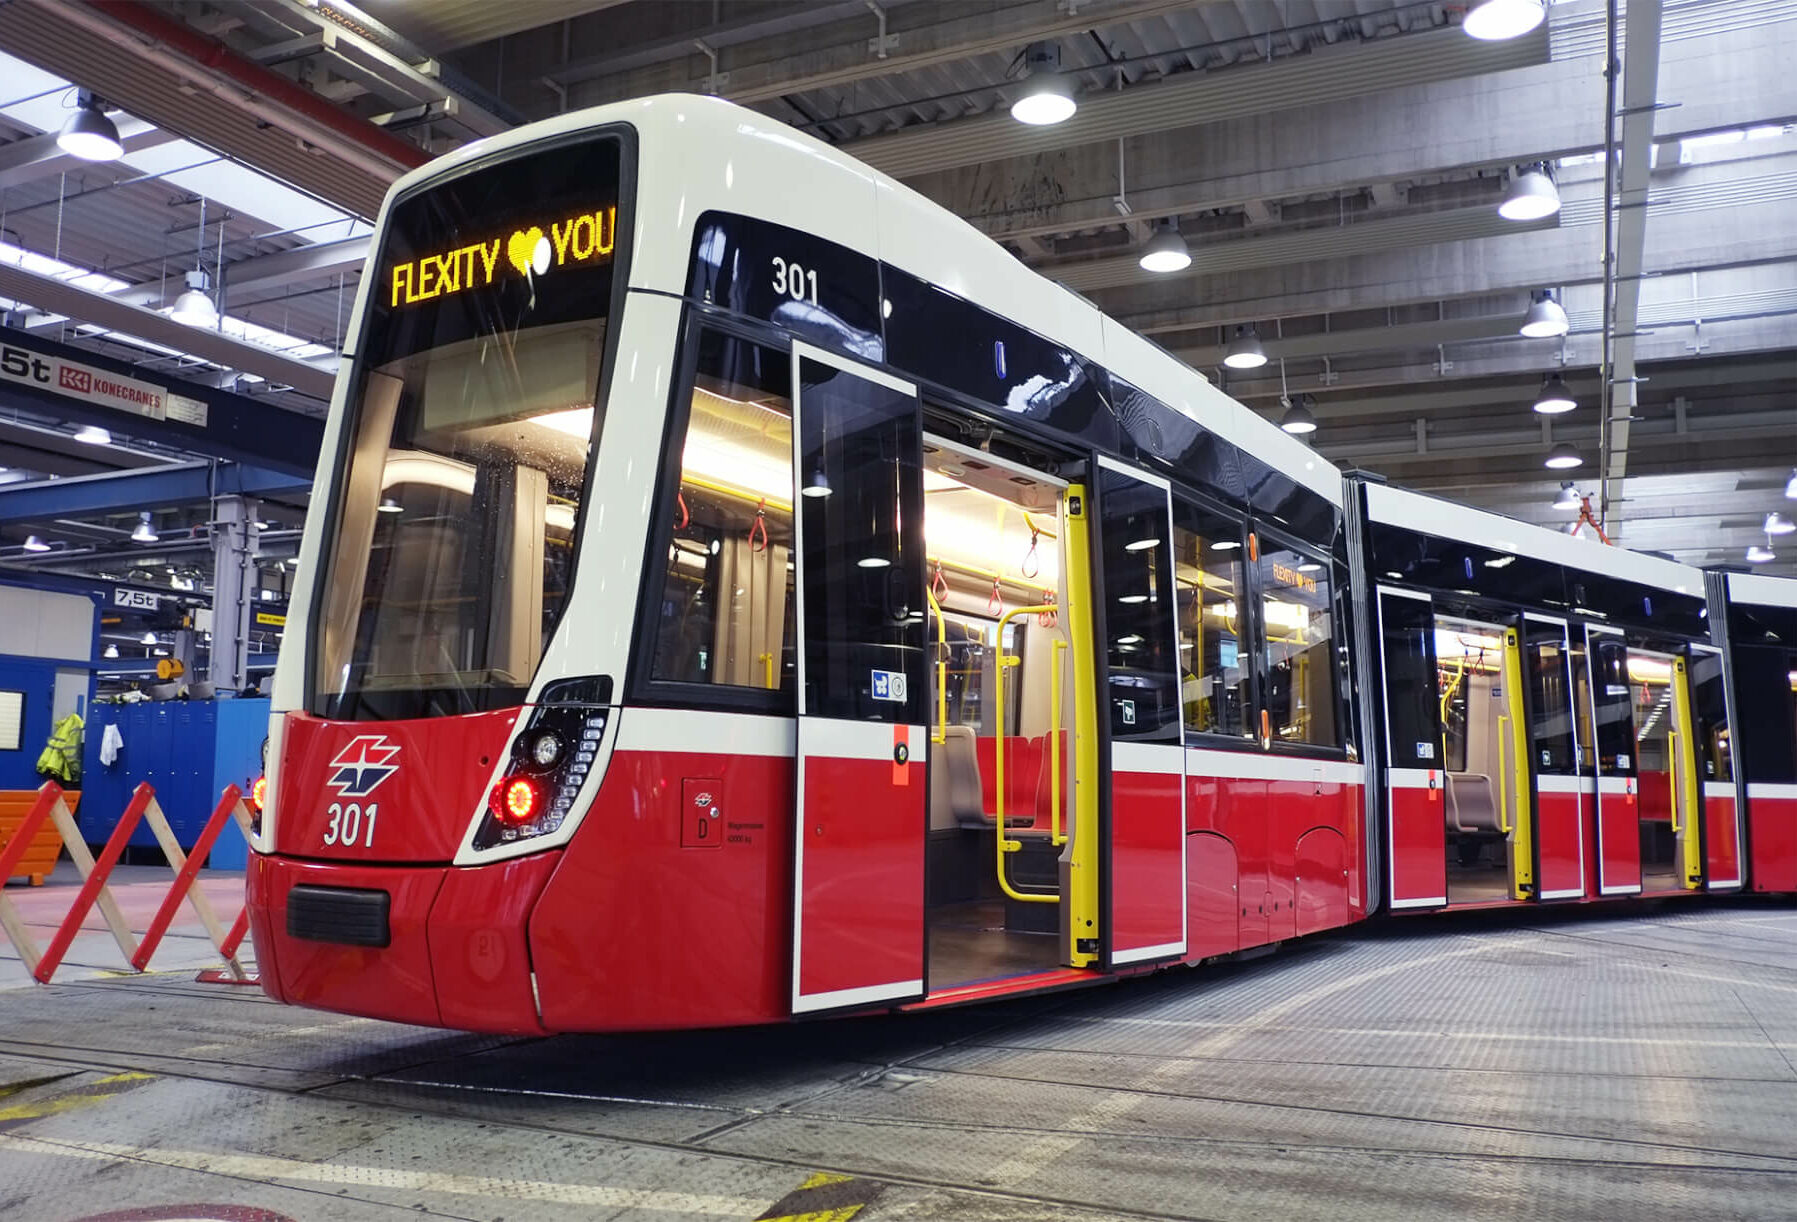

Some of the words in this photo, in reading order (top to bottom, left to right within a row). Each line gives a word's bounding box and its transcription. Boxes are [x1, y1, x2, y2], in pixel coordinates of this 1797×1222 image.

[391, 238, 500, 307] FLEXITY
[551, 207, 616, 266] YOU
[771, 256, 818, 307] 301
[94, 378, 161, 409] KONECRANES
[117, 590, 154, 606] 7,5t
[323, 802, 378, 848] 301
[698, 818, 708, 839] D
